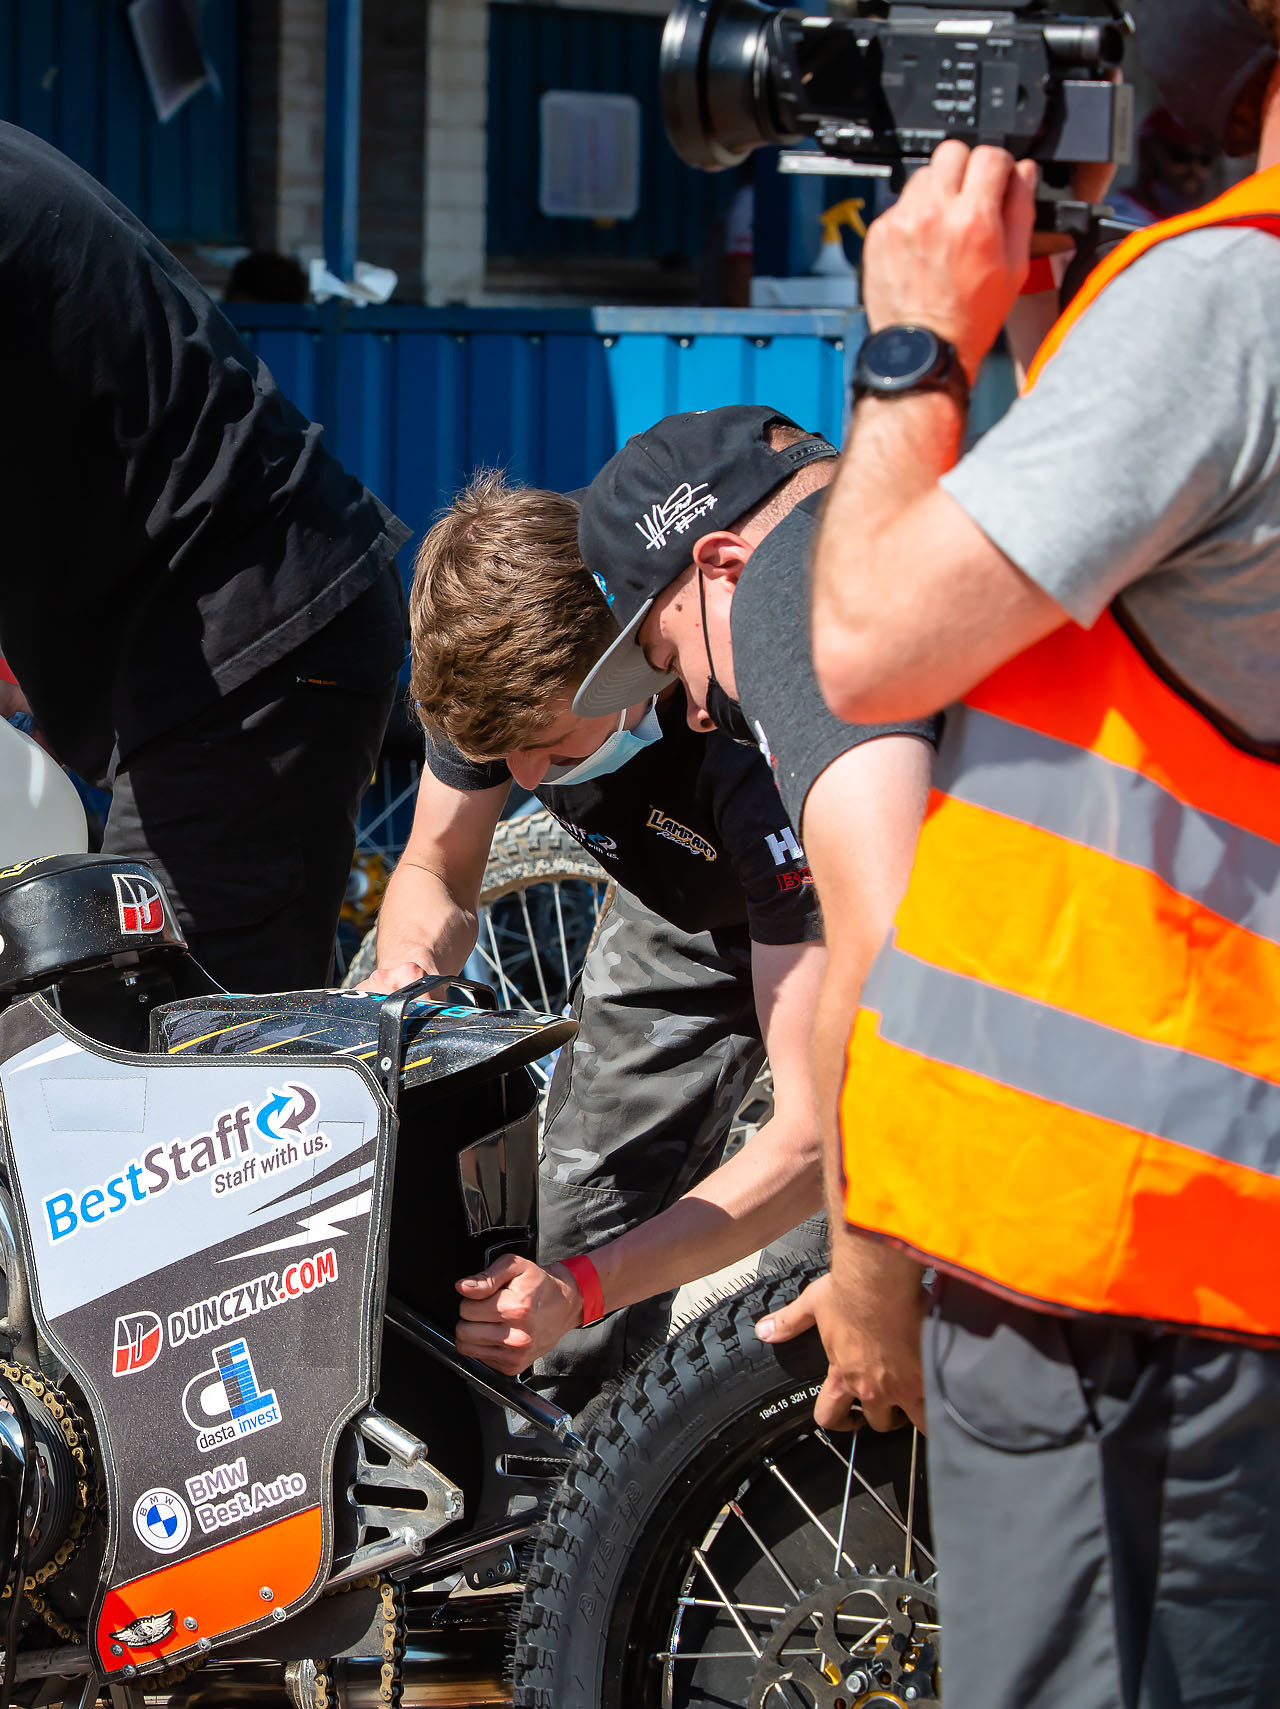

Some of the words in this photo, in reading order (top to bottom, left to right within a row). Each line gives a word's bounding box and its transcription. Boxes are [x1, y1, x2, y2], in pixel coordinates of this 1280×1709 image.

[45, 1106, 251, 1241] BestStaff
[215, 1158, 257, 1195] Staff
[260, 1142, 299, 1175] with
[303, 1134, 329, 1157] us.
[169, 1250, 337, 1346] DUNCZYK.COM
[789, 1390, 808, 1405] 32H
[808, 1384, 825, 1397] DO
[199, 1425, 236, 1450] dasta
[237, 1406, 279, 1434] invest
[140, 1495, 174, 1517] BMW
[187, 1460, 247, 1503] BMW
[198, 1495, 251, 1531] Best
[253, 1476, 305, 1510] Auto
